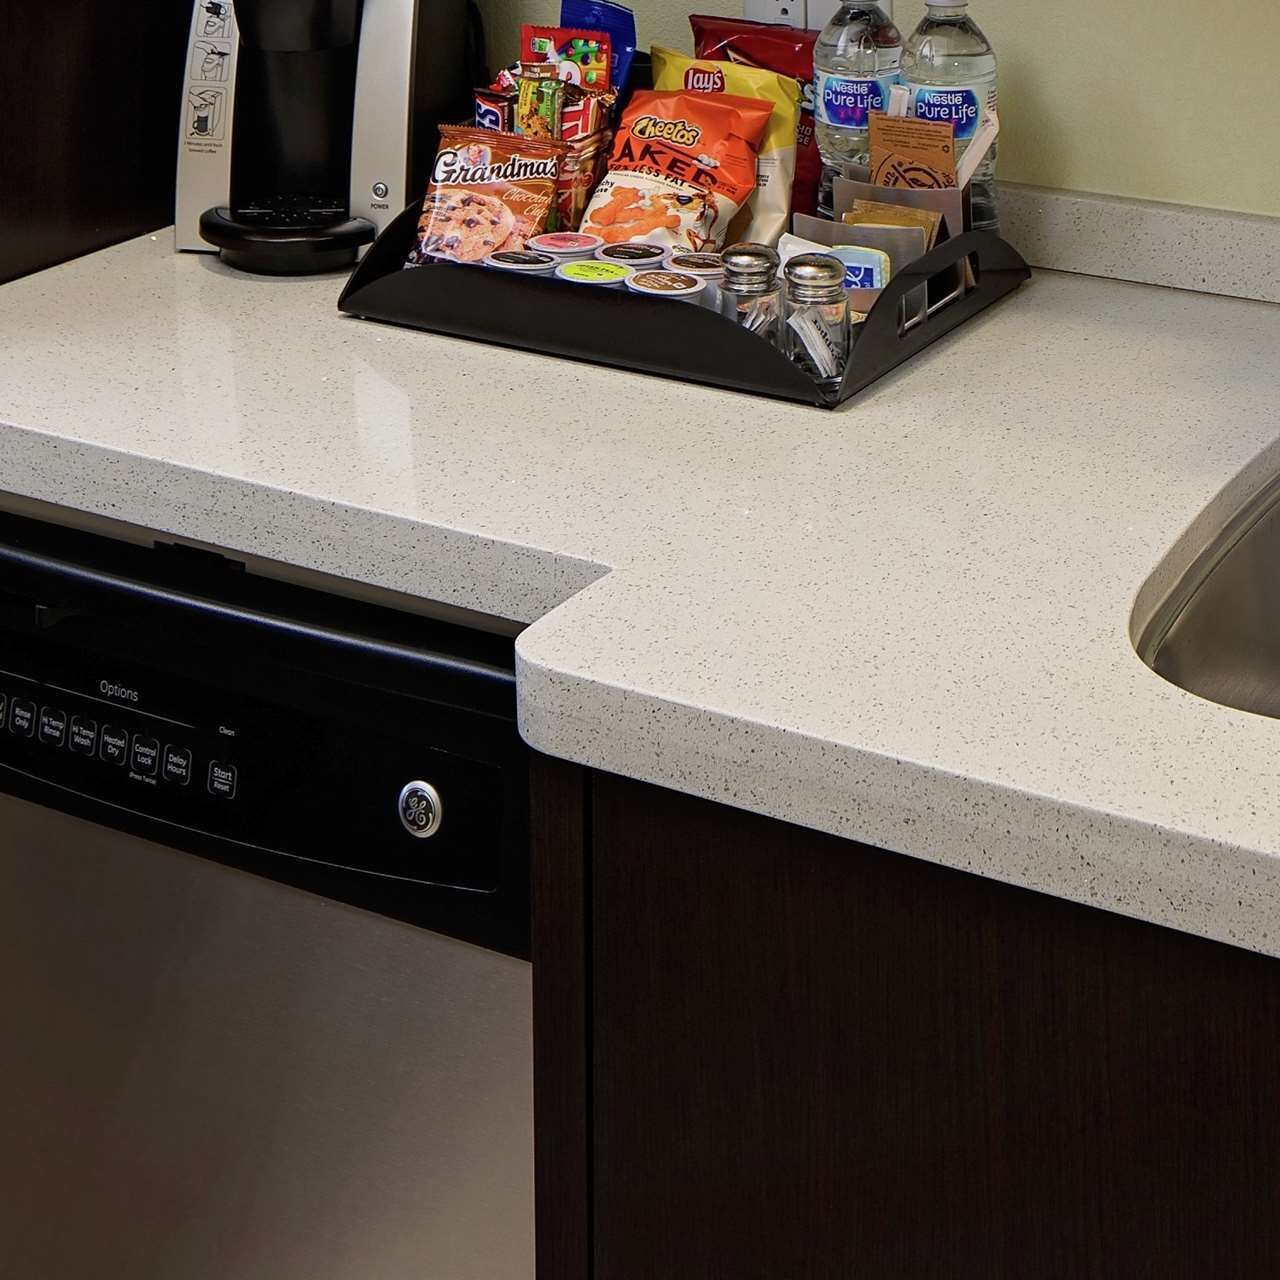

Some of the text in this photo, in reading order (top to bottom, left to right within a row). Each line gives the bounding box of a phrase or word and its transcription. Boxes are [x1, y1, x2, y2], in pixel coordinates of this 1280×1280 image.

[687, 68, 722, 92] Lay's
[824, 90, 854, 107] Pure
[857, 94, 882, 111] Life
[917, 103, 976, 123] Pure Life
[631, 116, 700, 146] Cheetos
[432, 150, 558, 184] Grandma's
[609, 137, 718, 188] AKED
[632, 164, 661, 178] LESS
[663, 175, 686, 187] FAT
[100, 680, 139, 701] Options
[15, 707, 31, 719] Rinse
[15, 717, 29, 729] Only
[49, 718, 65, 729] Temp
[80, 727, 95, 738] Temp
[219, 726, 235, 736] Clean
[74, 735, 91, 746] Wash
[104, 735, 125, 747] Heated
[108, 745, 119, 756] Dry
[135, 743, 157, 756] Control
[137, 754, 153, 765] Lock
[168, 753, 187, 767] Delay
[167, 763, 186, 776] Hours
[213, 767, 232, 781] Start
[213, 781, 230, 792] Reset
